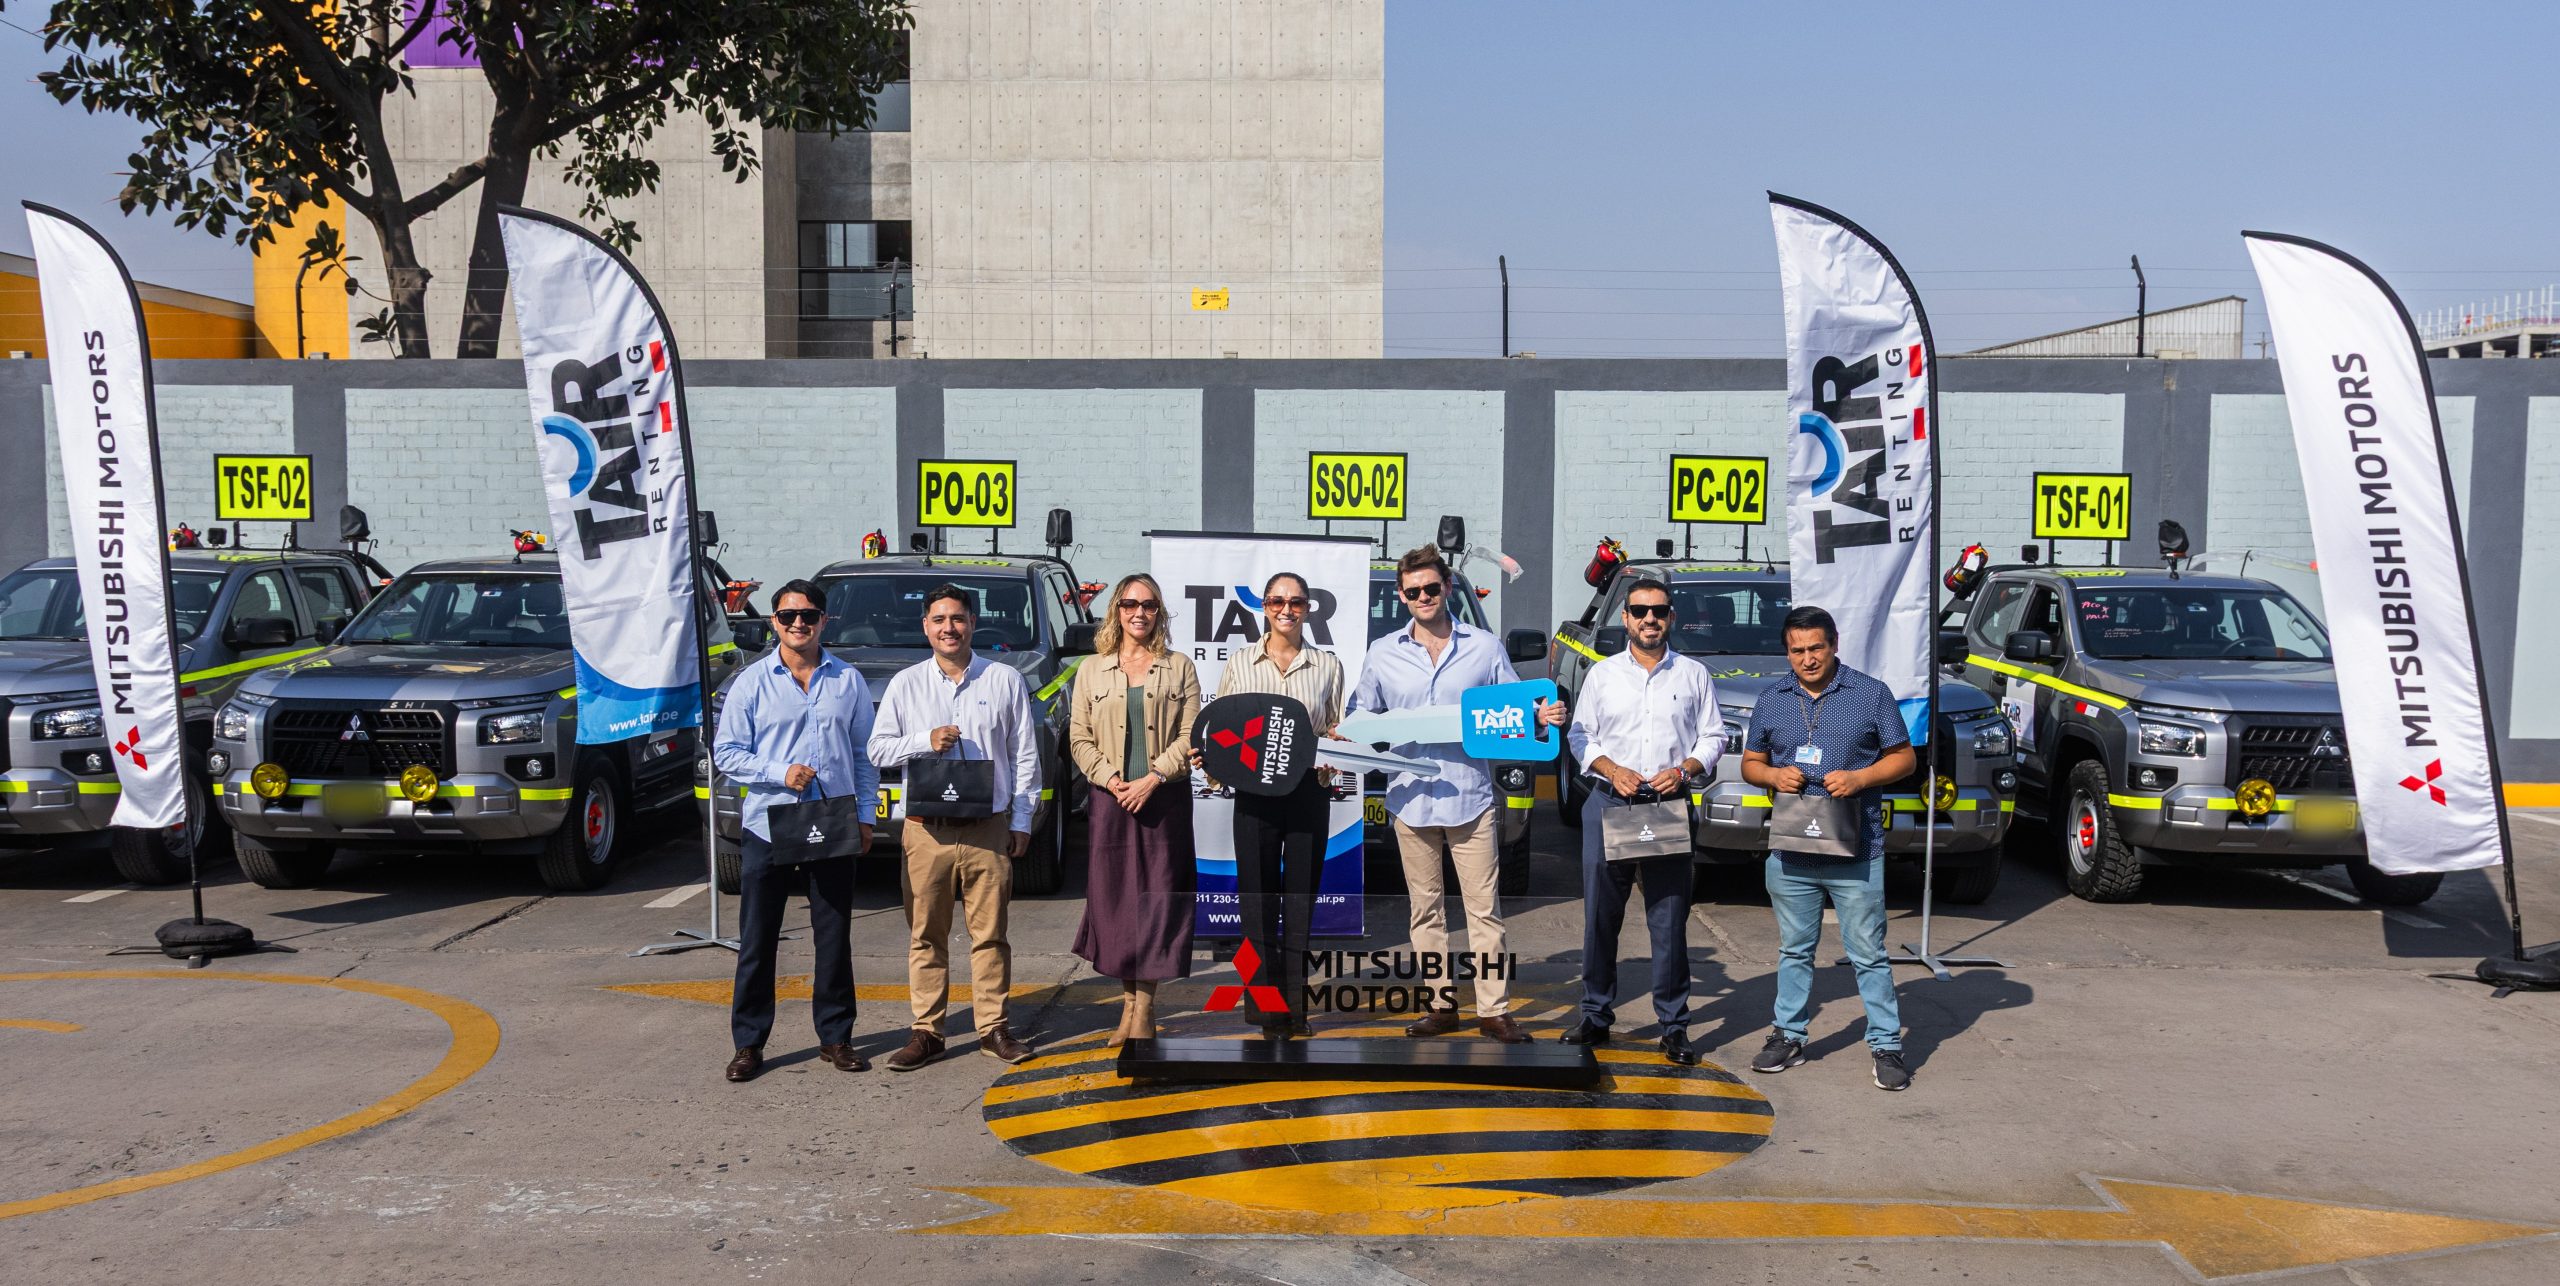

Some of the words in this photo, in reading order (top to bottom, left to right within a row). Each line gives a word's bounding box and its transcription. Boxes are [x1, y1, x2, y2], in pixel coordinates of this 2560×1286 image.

[84, 330, 122, 487] MOTORS
[2332, 353, 2397, 515] MOTORS
[550, 352, 650, 561] TAIR
[626, 344, 668, 533] RENTING
[1811, 353, 1892, 564] TAIR
[1885, 348, 1915, 543] RENTING
[223, 465, 306, 509] TSF-02
[925, 471, 1008, 517] PO-03
[1315, 463, 1399, 508] SSO-02
[1676, 467, 1760, 513] PC-02
[2041, 485, 2124, 529] TSF-01
[98, 500, 135, 714] MITSUBISHI
[1185, 585, 1337, 646] TAR
[2367, 527, 2438, 748] MITSUBISHI
[609, 710, 679, 733] www.tair.pe
[1261, 706, 1283, 784] MITSUBISHI
[1471, 705, 1525, 729] TAIR
[1276, 718, 1295, 776] MOTORS
[1302, 950, 1517, 981] MITSUBISHI
[1302, 984, 1459, 1014] MOTORS
